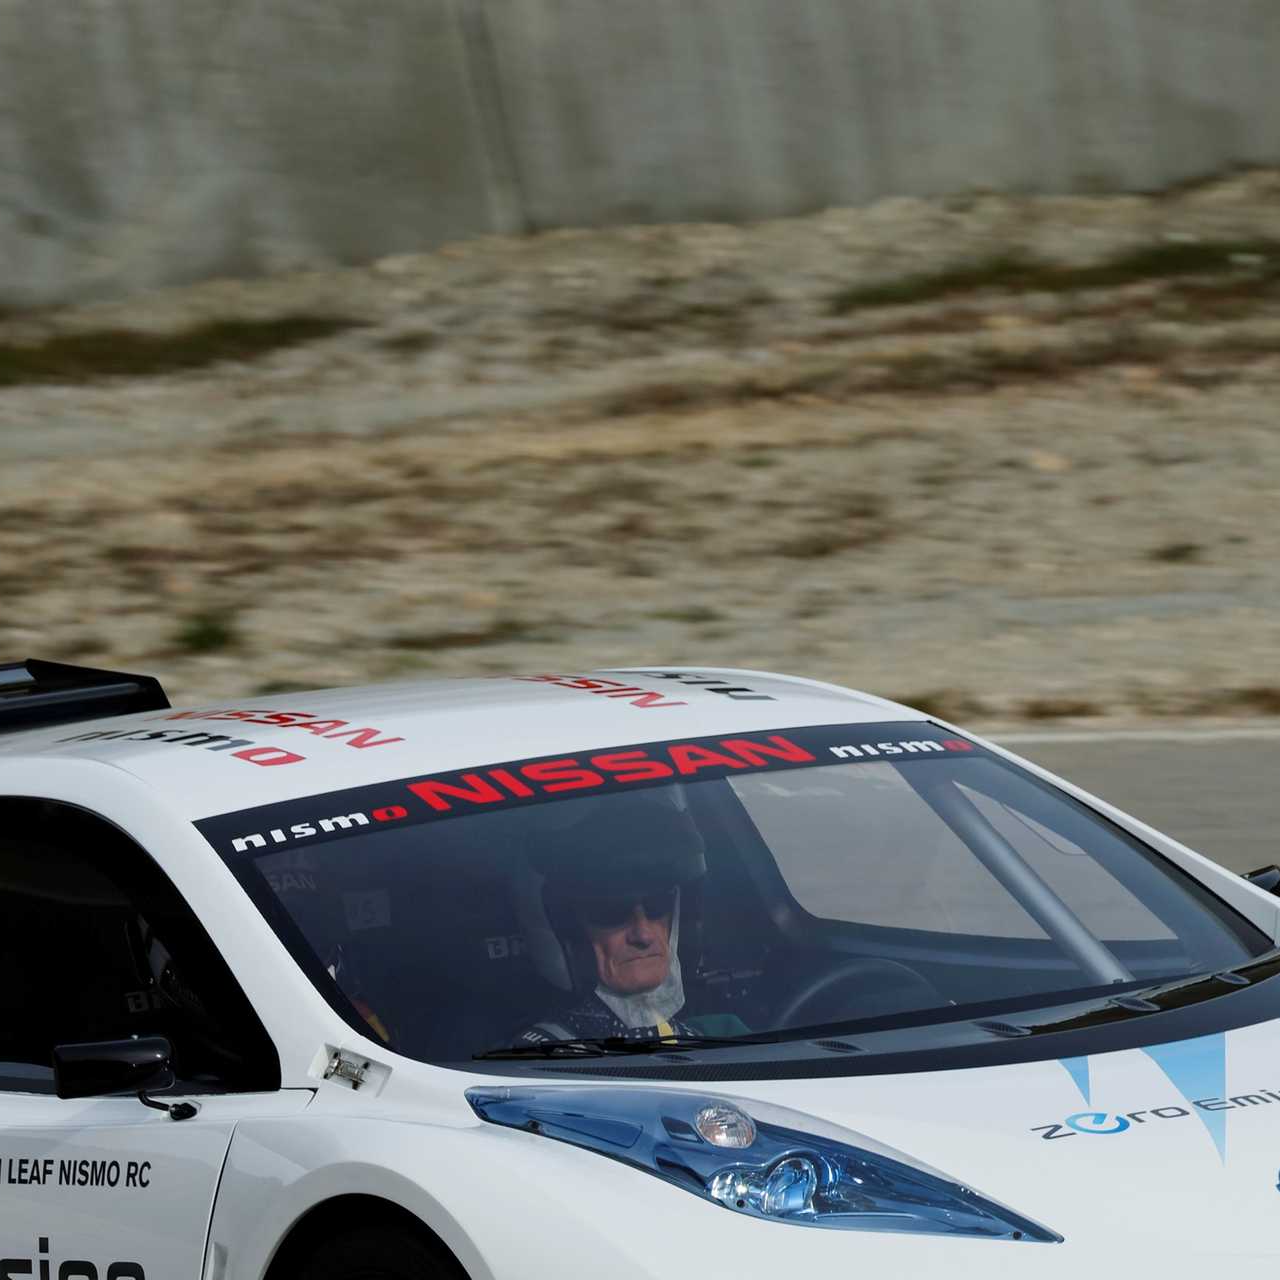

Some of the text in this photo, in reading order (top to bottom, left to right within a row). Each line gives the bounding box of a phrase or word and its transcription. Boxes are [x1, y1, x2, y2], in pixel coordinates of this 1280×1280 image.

[55, 729, 306, 766] nismo
[148, 709, 405, 749] NISSAN
[830, 737, 972, 760] nismo
[407, 736, 816, 811] NISSAN
[231, 805, 407, 852] nismo
[1031, 1107, 1190, 1140] zero
[7, 1158, 55, 1185] LEAF
[58, 1160, 121, 1188] NISMO
[125, 1161, 152, 1188] RC
